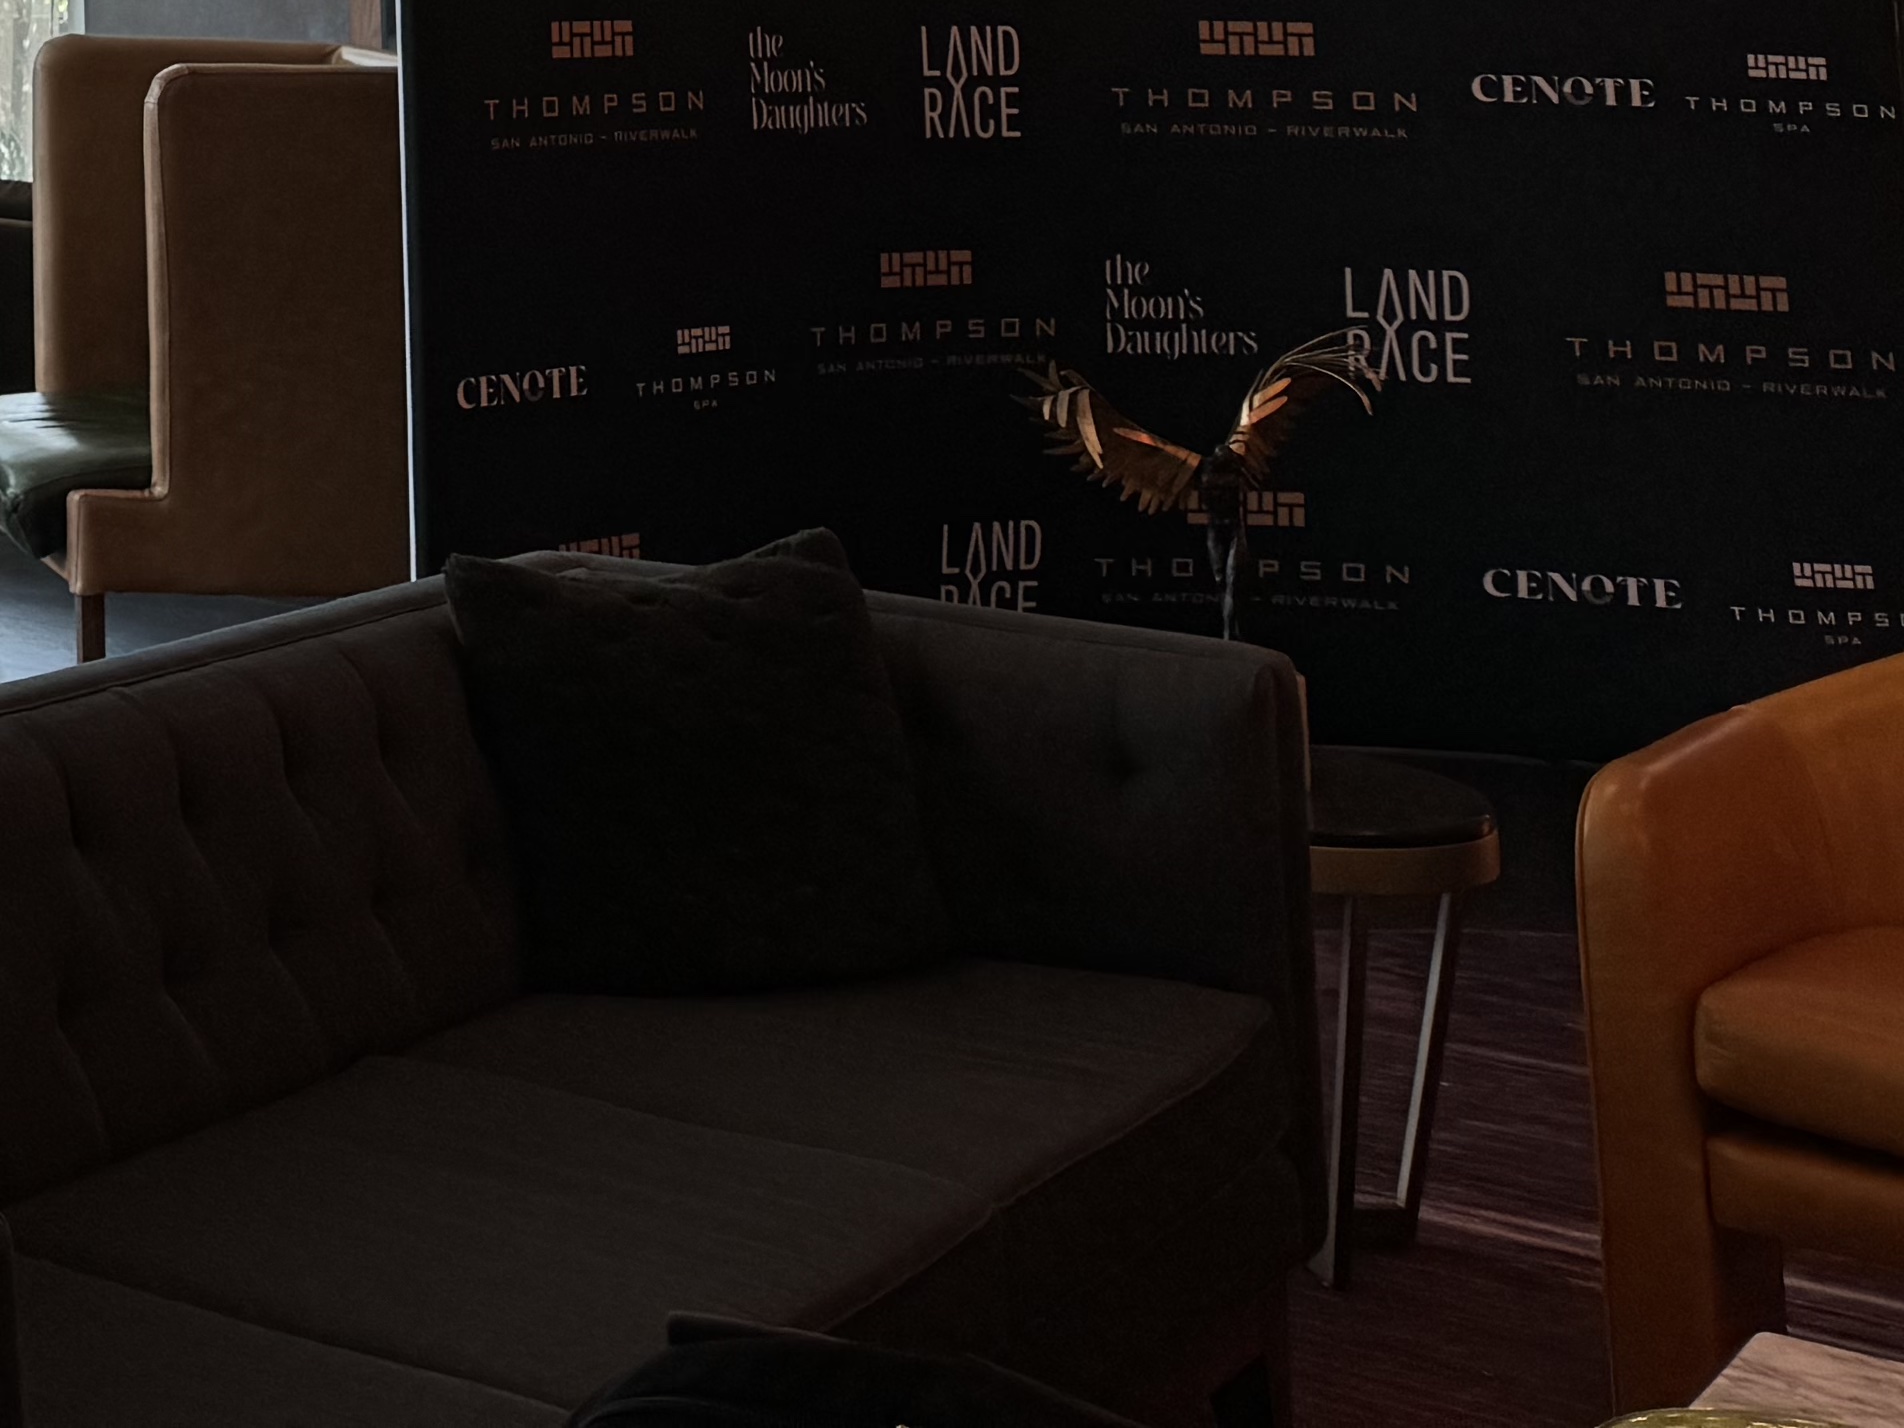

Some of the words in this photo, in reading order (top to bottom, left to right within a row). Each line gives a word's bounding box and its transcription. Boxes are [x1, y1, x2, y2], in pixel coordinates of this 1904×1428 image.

[748, 26, 784, 59] the
[920, 25, 1020, 77] LAND
[749, 61, 826, 93] Moon's
[1471, 74, 1656, 108] CENOTE
[484, 90, 705, 120] THOMPSON
[751, 97, 867, 135] Daughters
[924, 87, 1022, 139] RACE
[1110, 88, 1418, 113] THOMPSON
[1684, 96, 1896, 120] THOMPSON
[1773, 123, 1811, 134] SPA
[1105, 253, 1150, 285] the
[1105, 288, 1205, 319] Moon's
[1344, 267, 1471, 321] LAND
[810, 317, 1056, 347] THOMPSON
[1107, 323, 1258, 360] Daughters
[1347, 328, 1472, 384] RACE
[1565, 337, 1896, 372] THOMPSON
[456, 366, 588, 410] CENOTE
[636, 369, 777, 398] THOMPSON
[942, 520, 1044, 575] LAND
[1094, 558, 1411, 584] THOPSON
[1482, 568, 1683, 609] CENOTE
[1730, 606, 1904, 628] THOMPS
